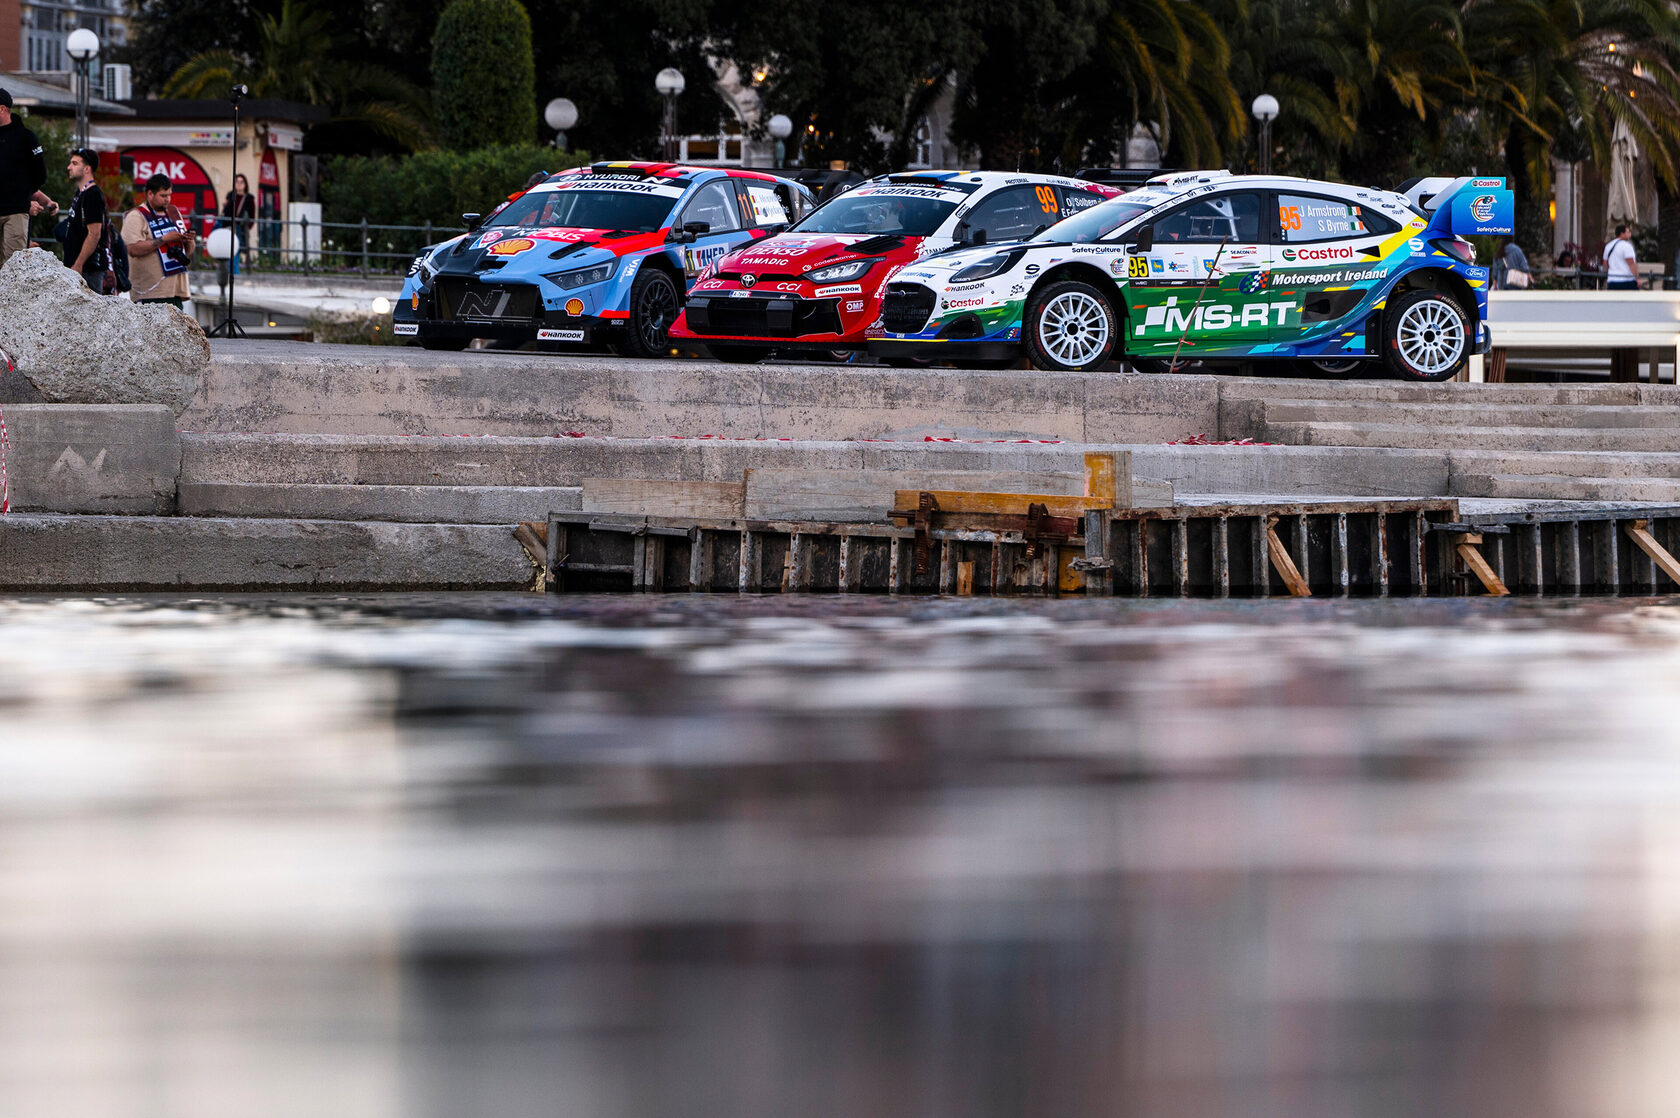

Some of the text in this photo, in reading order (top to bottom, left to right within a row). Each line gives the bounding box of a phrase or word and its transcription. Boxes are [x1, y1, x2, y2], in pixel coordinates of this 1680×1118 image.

[133, 161, 186, 180] ISAK
[573, 181, 658, 193] Hankook
[869, 188, 947, 198] Hankook
[1034, 185, 1059, 214] 99
[738, 192, 753, 221] 11
[1299, 204, 1347, 219] J Armstrong
[1278, 205, 1302, 231] 95
[1318, 219, 1349, 234] S Byrne
[512, 230, 585, 241] MOBIS
[745, 248, 808, 256] DENSO
[1071, 247, 1121, 255] SafetyCulture
[1297, 246, 1353, 260] Castrol
[740, 258, 789, 266] TAMADIC
[1128, 256, 1149, 277] 95
[1272, 268, 1389, 286] Motorsport Ireland
[702, 280, 726, 289] CCI
[776, 282, 802, 291] CCI
[825, 286, 860, 294] Hankook
[950, 281, 985, 293] Hankook
[846, 302, 864, 310] OMP
[950, 297, 984, 309] Castrol
[1165, 301, 1297, 333] MS-RT
